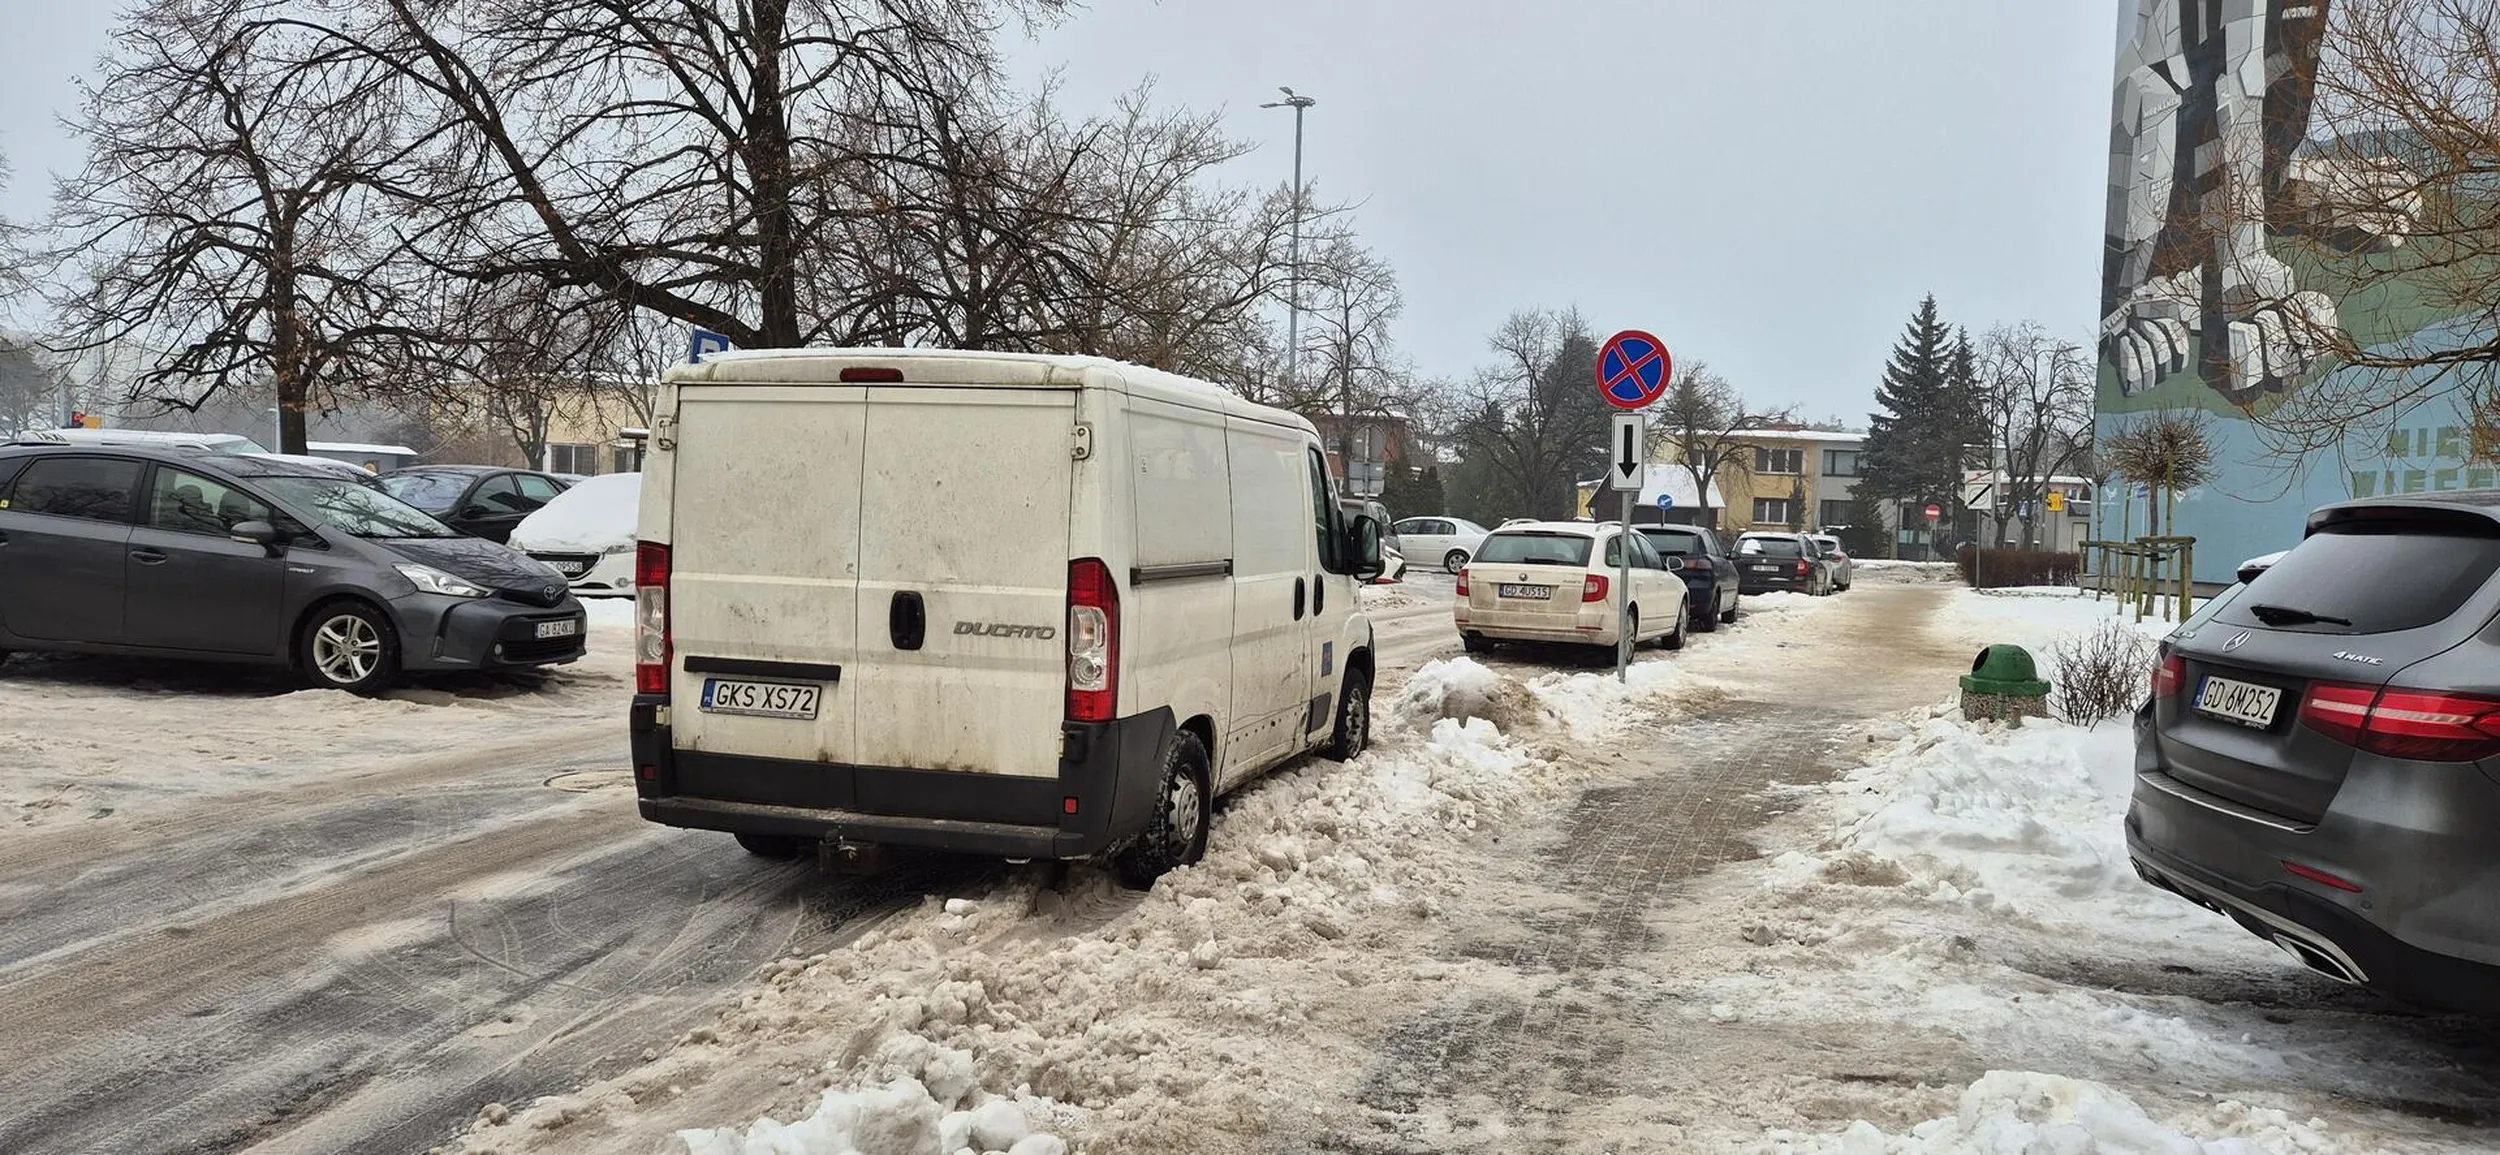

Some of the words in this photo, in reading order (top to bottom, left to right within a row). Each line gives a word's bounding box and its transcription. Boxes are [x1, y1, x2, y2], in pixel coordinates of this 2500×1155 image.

[31, 431, 68, 442] TAXI
[1504, 585, 1518, 596] GD
[953, 621, 1056, 640] DUCATO
[2333, 650, 2384, 666] 4MATIC
[716, 683, 756, 707] GKS
[761, 686, 813, 711] XS72
[2203, 680, 2226, 708] GD
[2225, 684, 2276, 721] 6M252
